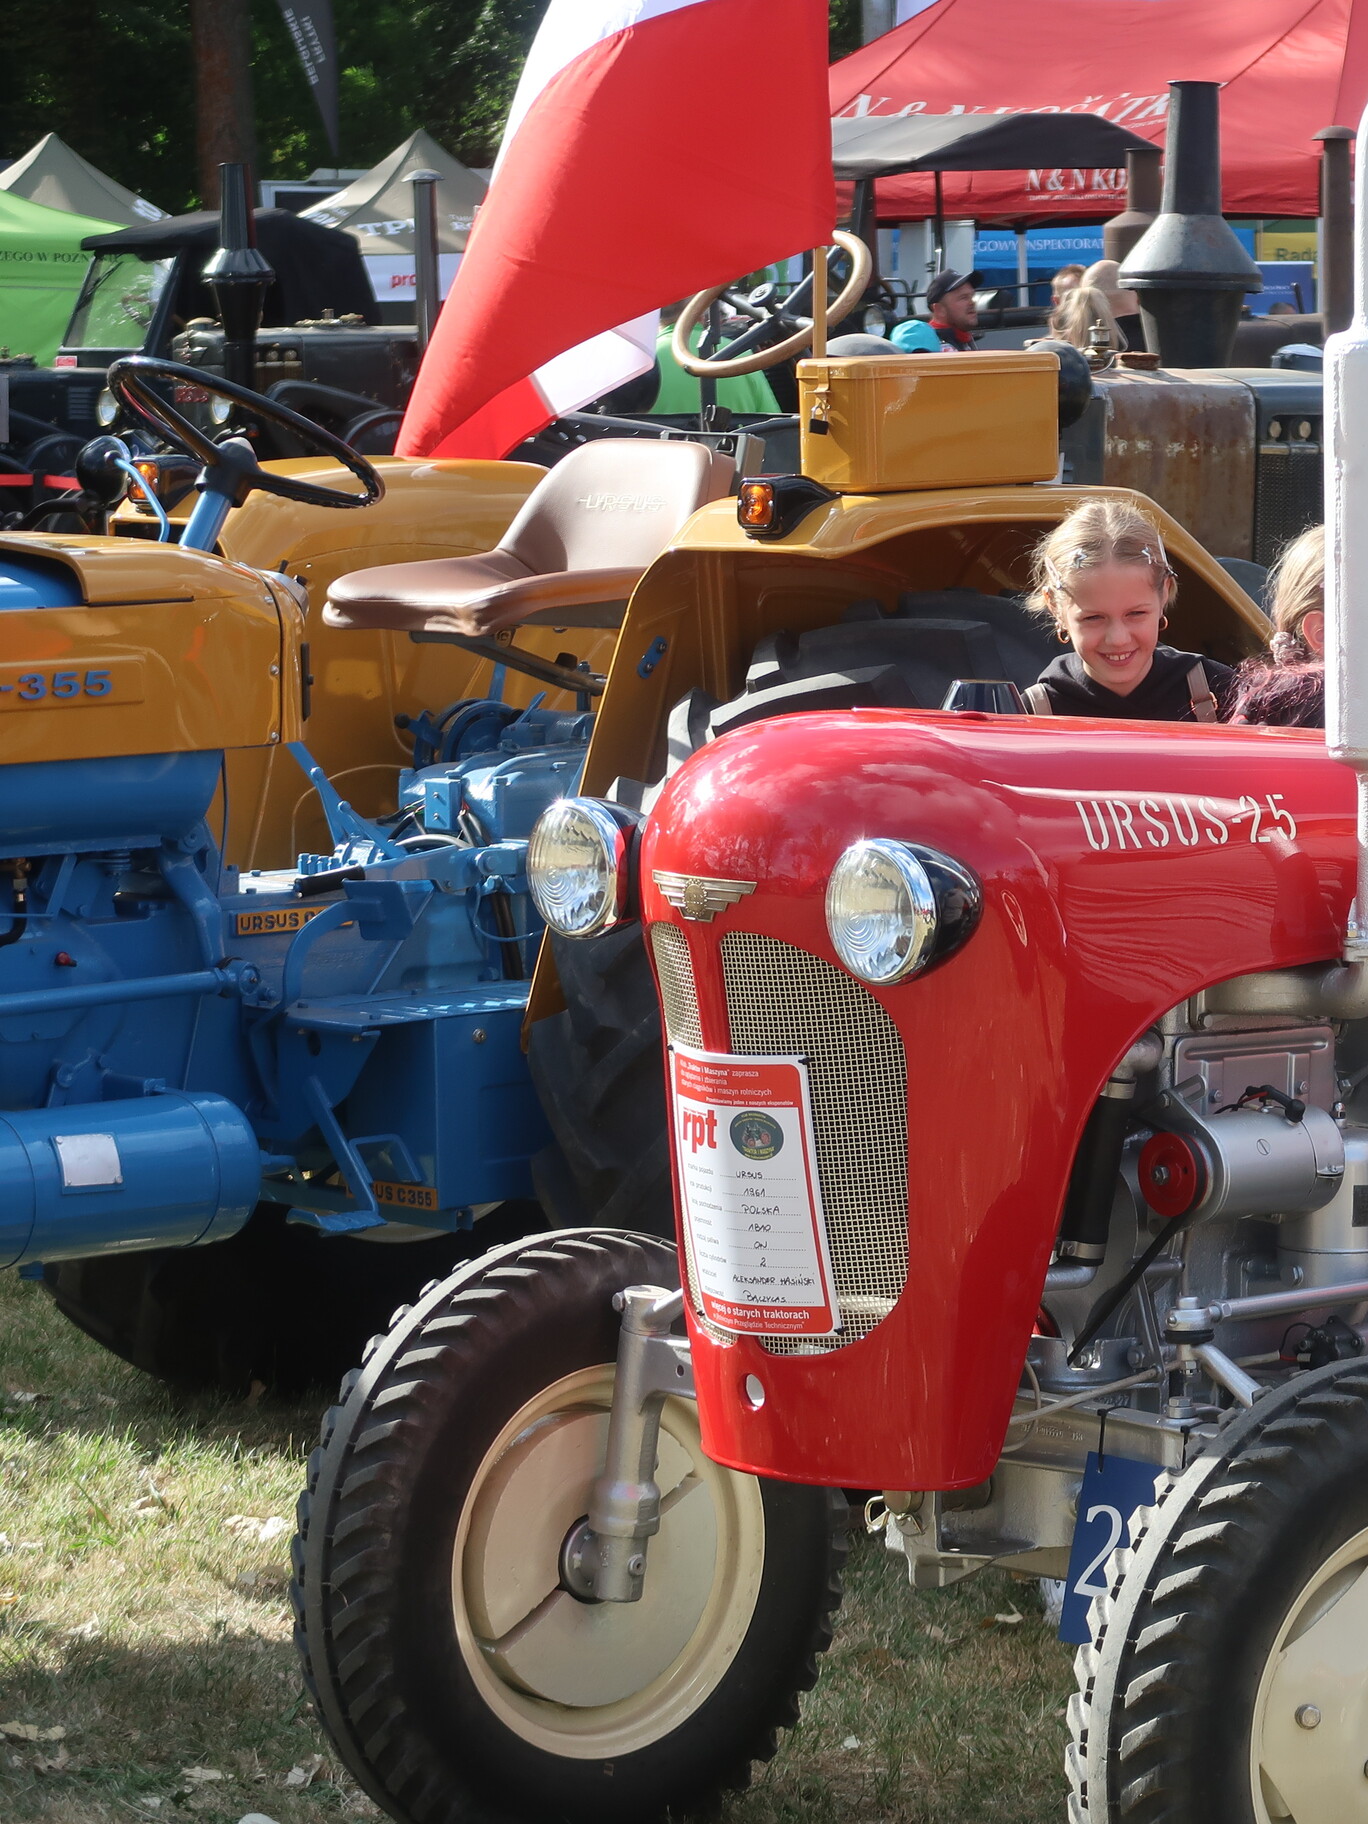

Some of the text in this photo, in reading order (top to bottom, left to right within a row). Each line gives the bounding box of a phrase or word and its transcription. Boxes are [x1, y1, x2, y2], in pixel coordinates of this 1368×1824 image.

[585, 494, 665, 512] URSUS
[240, 912, 300, 931] URSUS
[732, 1070, 759, 1078] zaprasza
[740, 1088, 772, 1097] rolniczych
[682, 1109, 718, 1154] rpt
[735, 1170, 763, 1179] URSUS
[741, 1203, 780, 1215] POLSKA
[760, 1256, 767, 1268] 2
[733, 1307, 761, 1319] starych
[763, 1310, 810, 1320] traktorach
